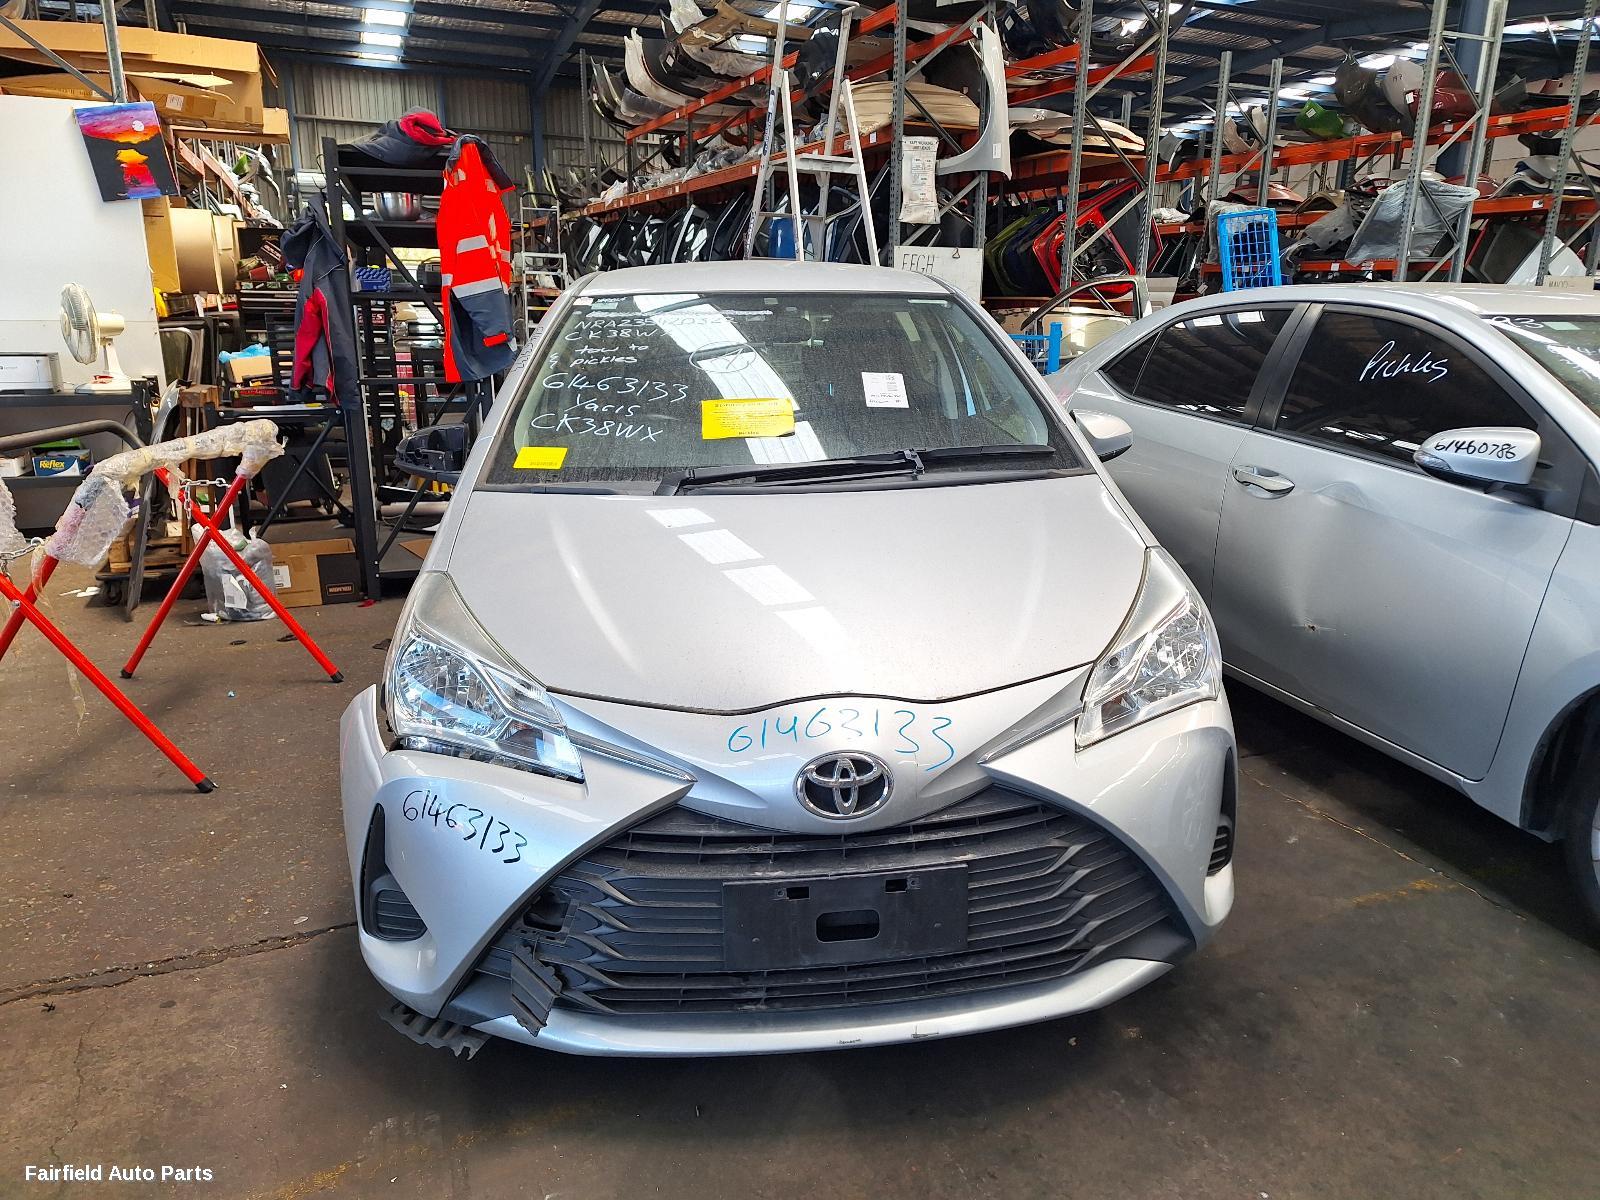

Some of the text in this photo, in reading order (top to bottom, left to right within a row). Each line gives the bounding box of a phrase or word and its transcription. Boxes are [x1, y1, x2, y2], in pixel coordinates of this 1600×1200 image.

[629, 343, 649, 351] to
[542, 372, 689, 403] 61463133
[564, 393, 641, 417] Yaris
[531, 413, 664, 442] CK38WX
[39, 459, 65, 469] Reflex
[728, 707, 955, 772] 61463133
[403, 789, 528, 864] 61463133
